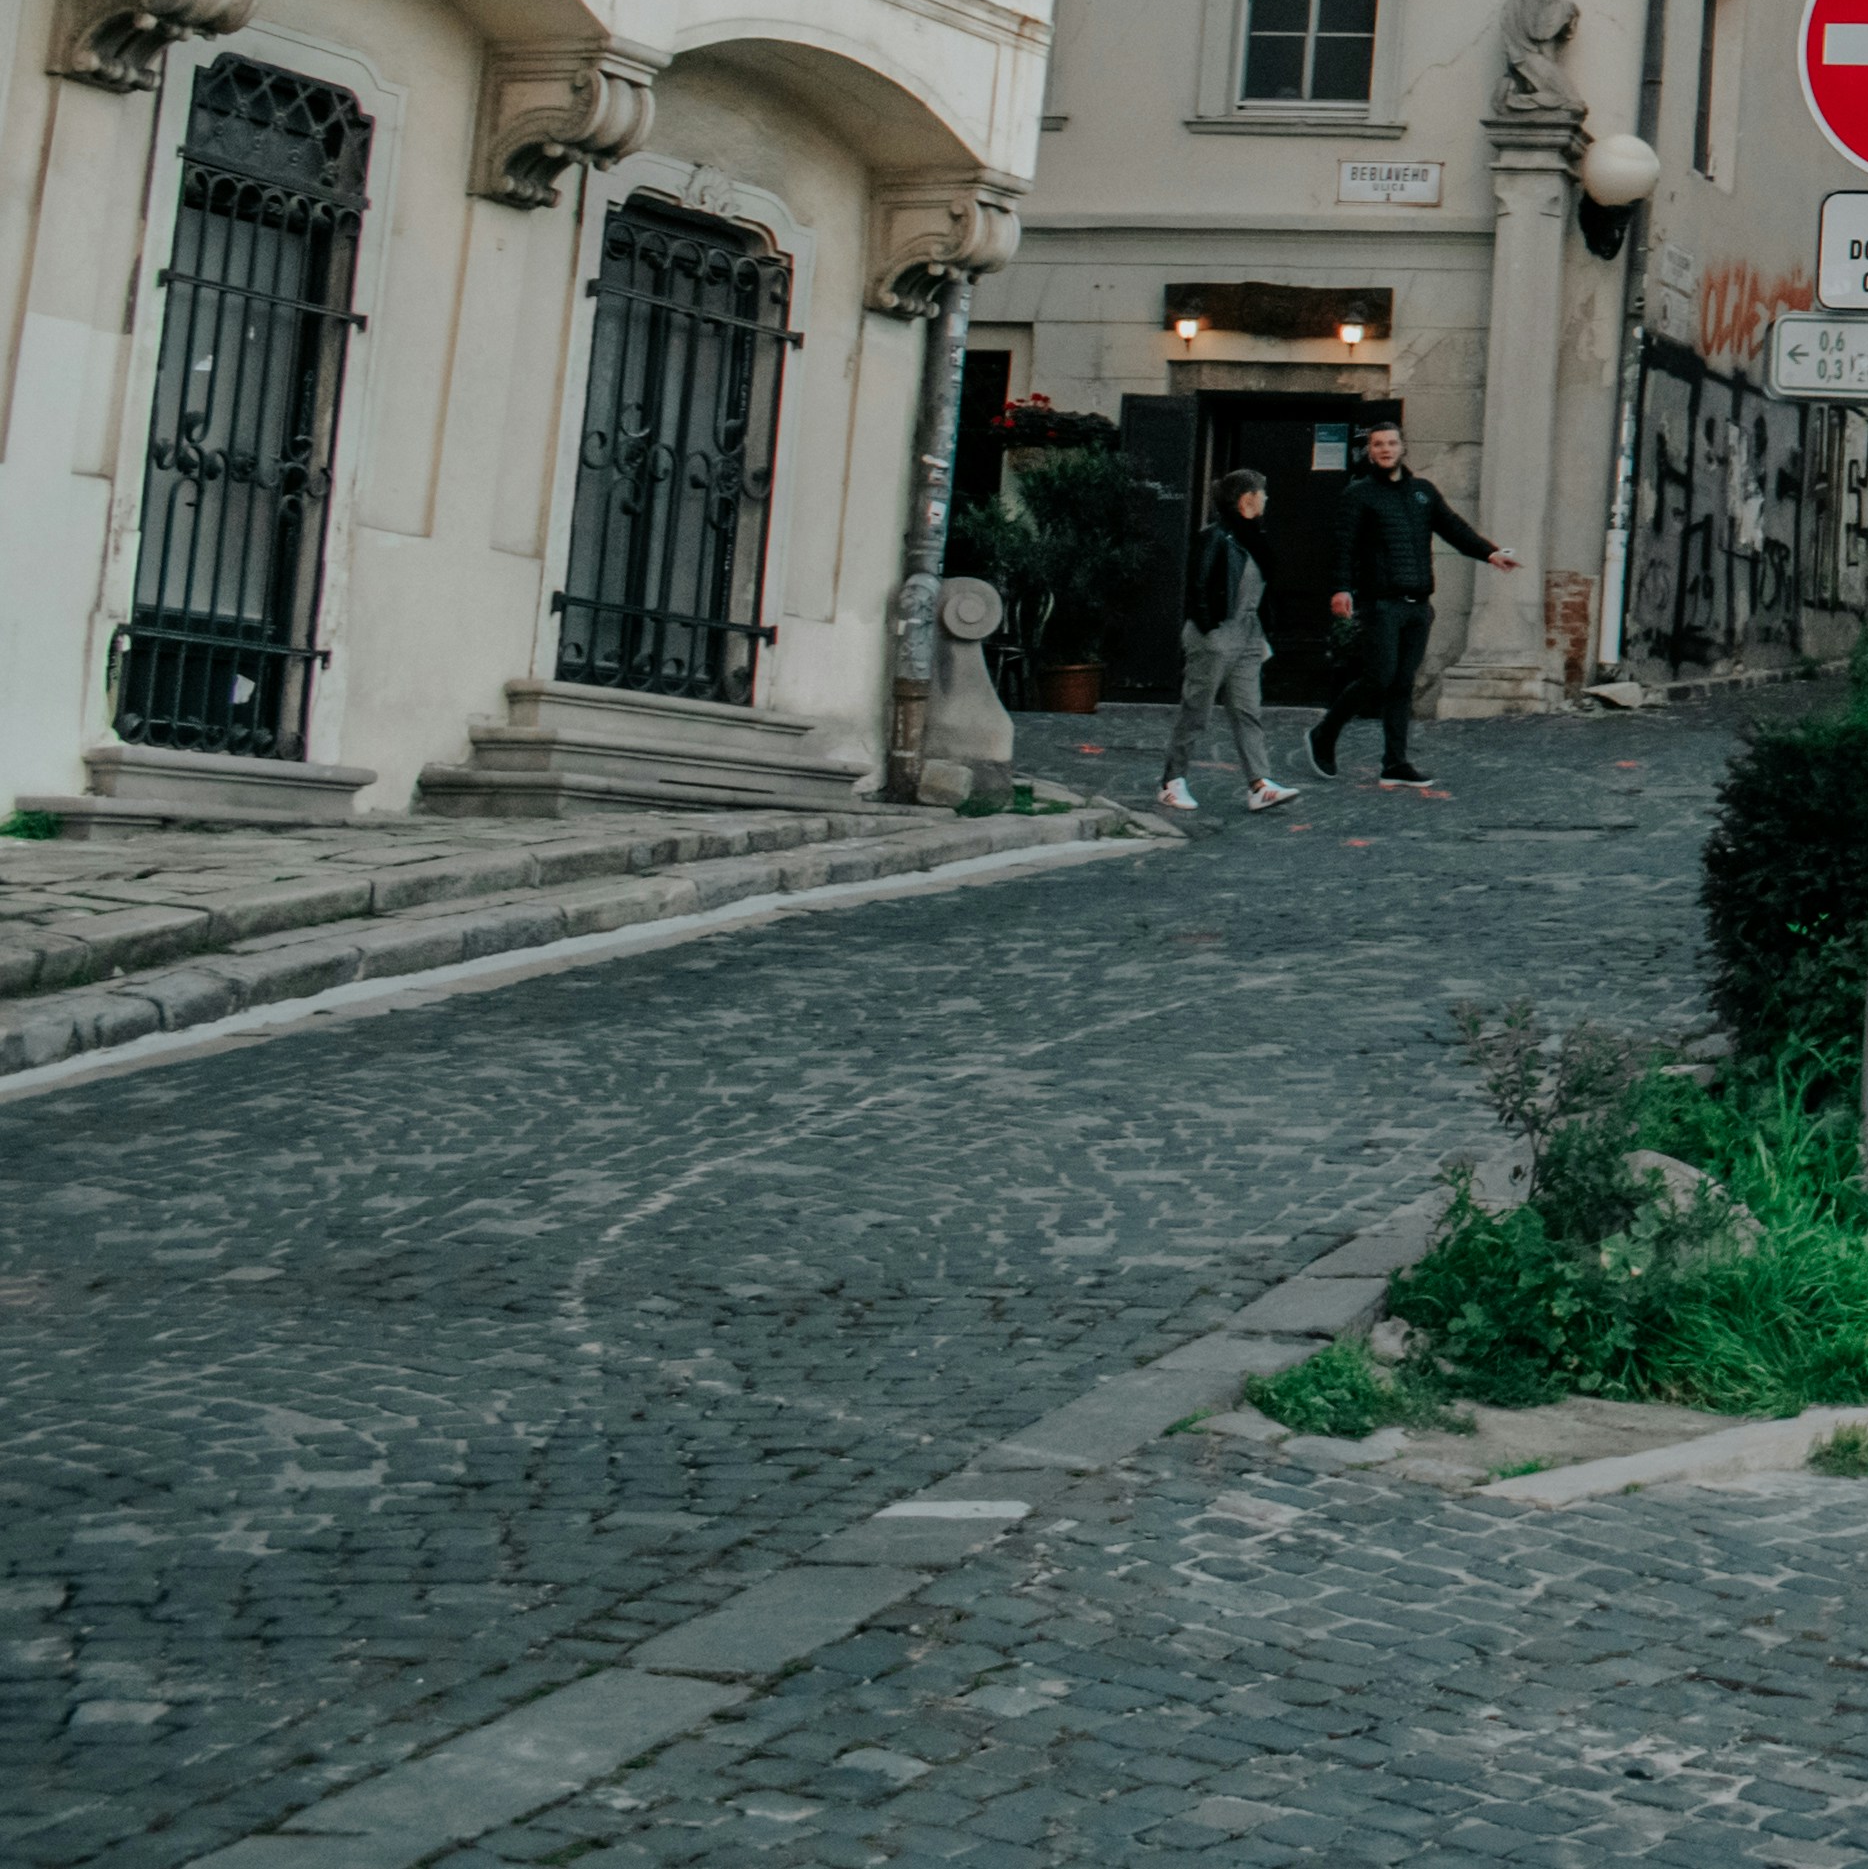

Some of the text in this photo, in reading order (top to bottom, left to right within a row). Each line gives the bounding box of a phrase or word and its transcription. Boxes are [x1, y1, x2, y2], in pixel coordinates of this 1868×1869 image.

[1350, 165, 1429, 182] BEBLAVÉHO
[1372, 182, 1405, 191] ULICA
[1819, 330, 1845, 355] 0,6
[1817, 358, 1843, 383] 0,3
